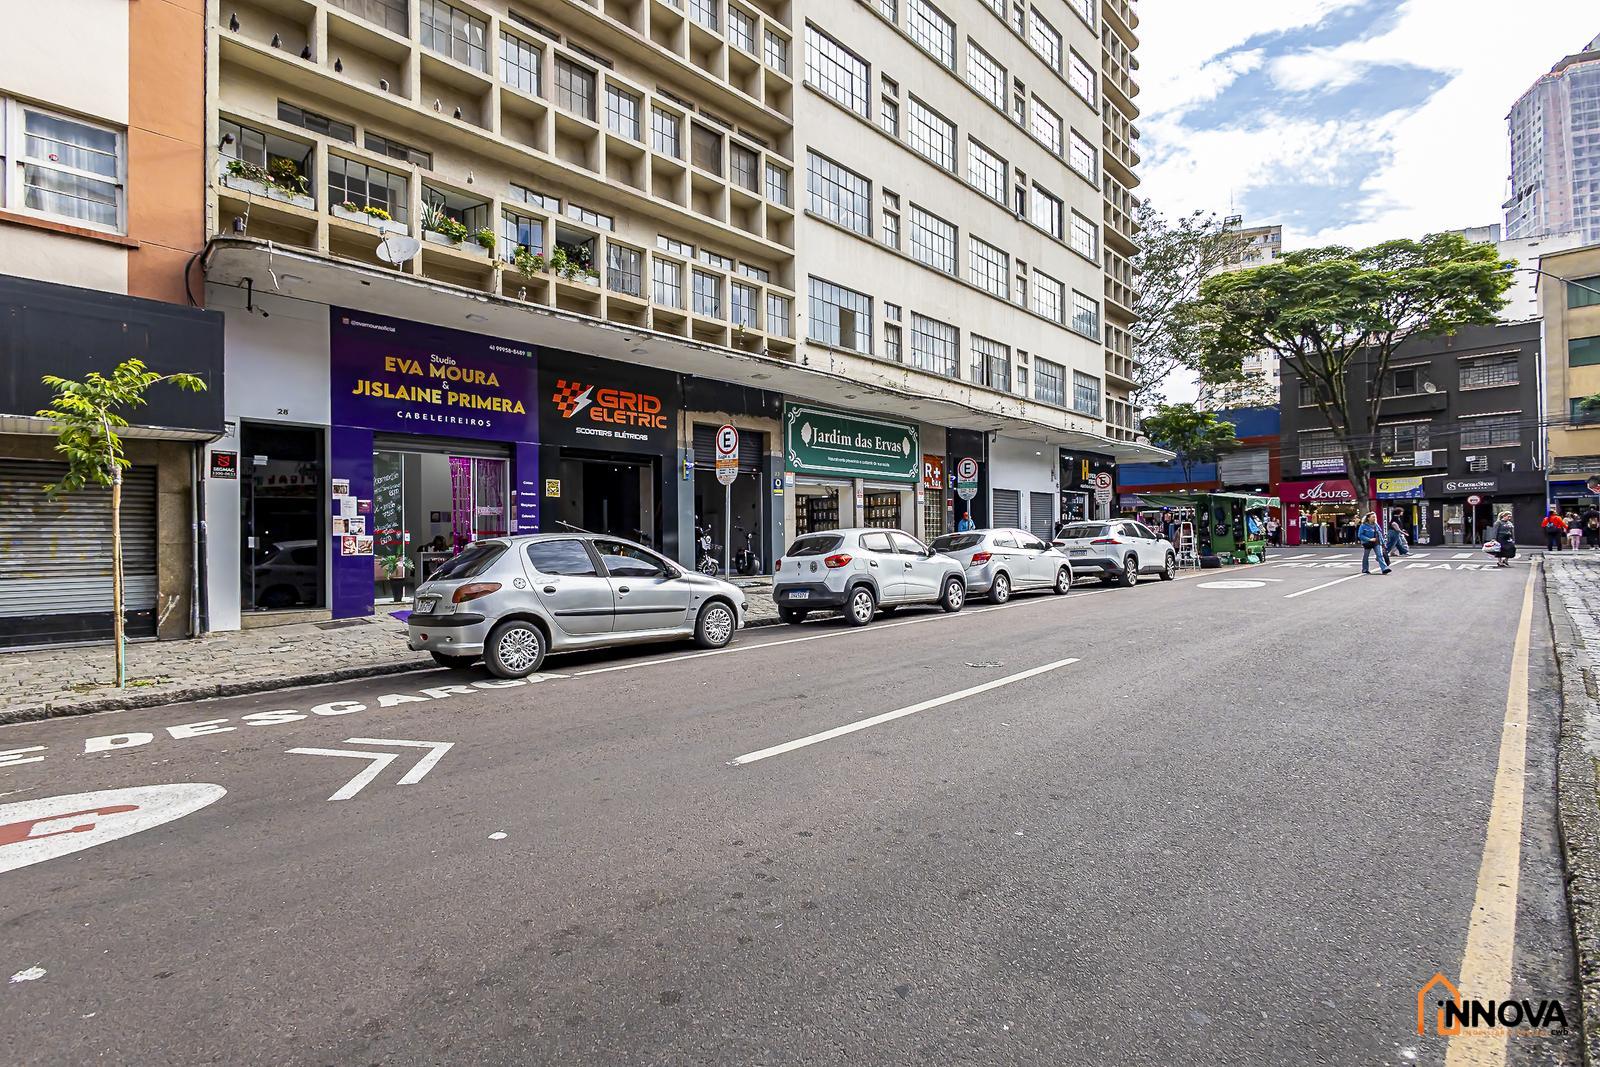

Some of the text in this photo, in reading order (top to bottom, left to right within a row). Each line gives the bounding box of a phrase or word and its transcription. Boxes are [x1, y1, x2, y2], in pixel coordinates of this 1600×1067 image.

[430, 354, 457, 366] Studio
[384, 356, 500, 387] EVA MOURA
[442, 380, 450, 390] &
[352, 379, 526, 415] JISLAINE PRIMERA
[596, 388, 662, 414] GRID
[397, 410, 492, 427] CABELEIREIROS
[589, 406, 667, 429] ELETRIC
[575, 427, 649, 441] SCOOTERS ELÉTRICAS
[723, 431, 731, 448] E
[812, 427, 902, 453] Jardim das Ervas
[964, 462, 971, 474] E
[84, 671, 572, 754] DESCARGA
